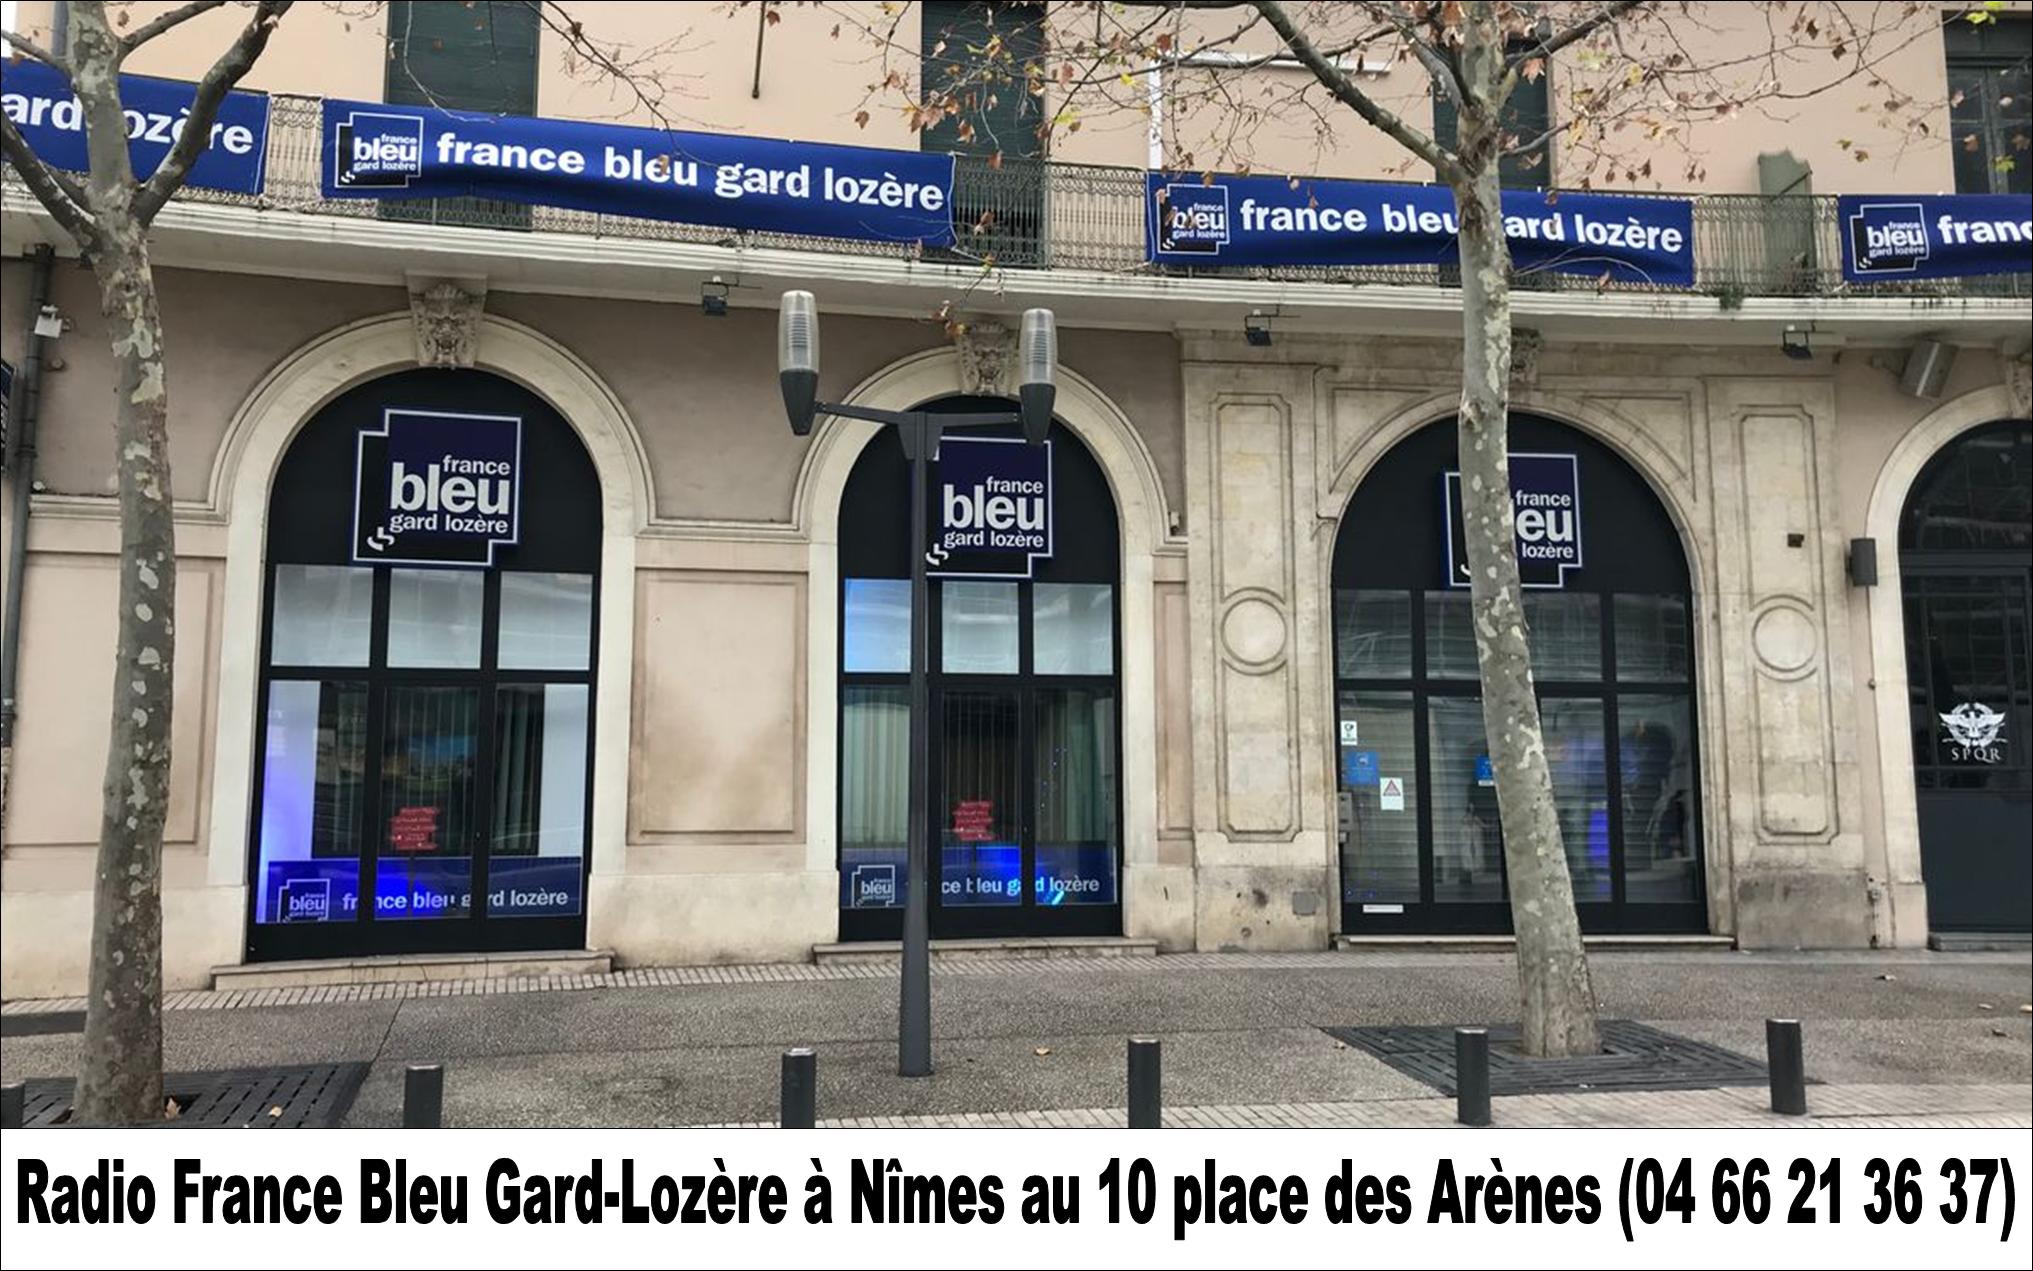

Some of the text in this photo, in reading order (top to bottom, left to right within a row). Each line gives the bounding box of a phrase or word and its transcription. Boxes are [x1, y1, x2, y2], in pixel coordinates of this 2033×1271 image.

[124, 107, 254, 155] ozre
[352, 137, 417, 162] bleu
[437, 132, 944, 211] france bleu gard lozère
[1240, 198, 1368, 231] france
[1501, 211, 1566, 242] ard
[1574, 213, 1684, 253] lozère
[1866, 225, 1924, 248] bleu
[442, 454, 511, 475] france
[390, 462, 510, 515] bleu
[986, 476, 1044, 494] france
[943, 484, 1045, 530] bleu
[1515, 490, 1571, 507] france
[389, 513, 509, 534] gard lozère
[1516, 508, 1574, 542] eu
[943, 530, 1044, 549] gard lozère
[1521, 541, 1574, 559] lozère
[1951, 747, 2001, 763] SPQR
[861, 880, 892, 895] bleu
[1050, 875, 1100, 893] lozère
[289, 895, 325, 911] bleu
[342, 892, 408, 911] frnce
[460, 889, 504, 908] grd
[510, 886, 569, 907] lozère
